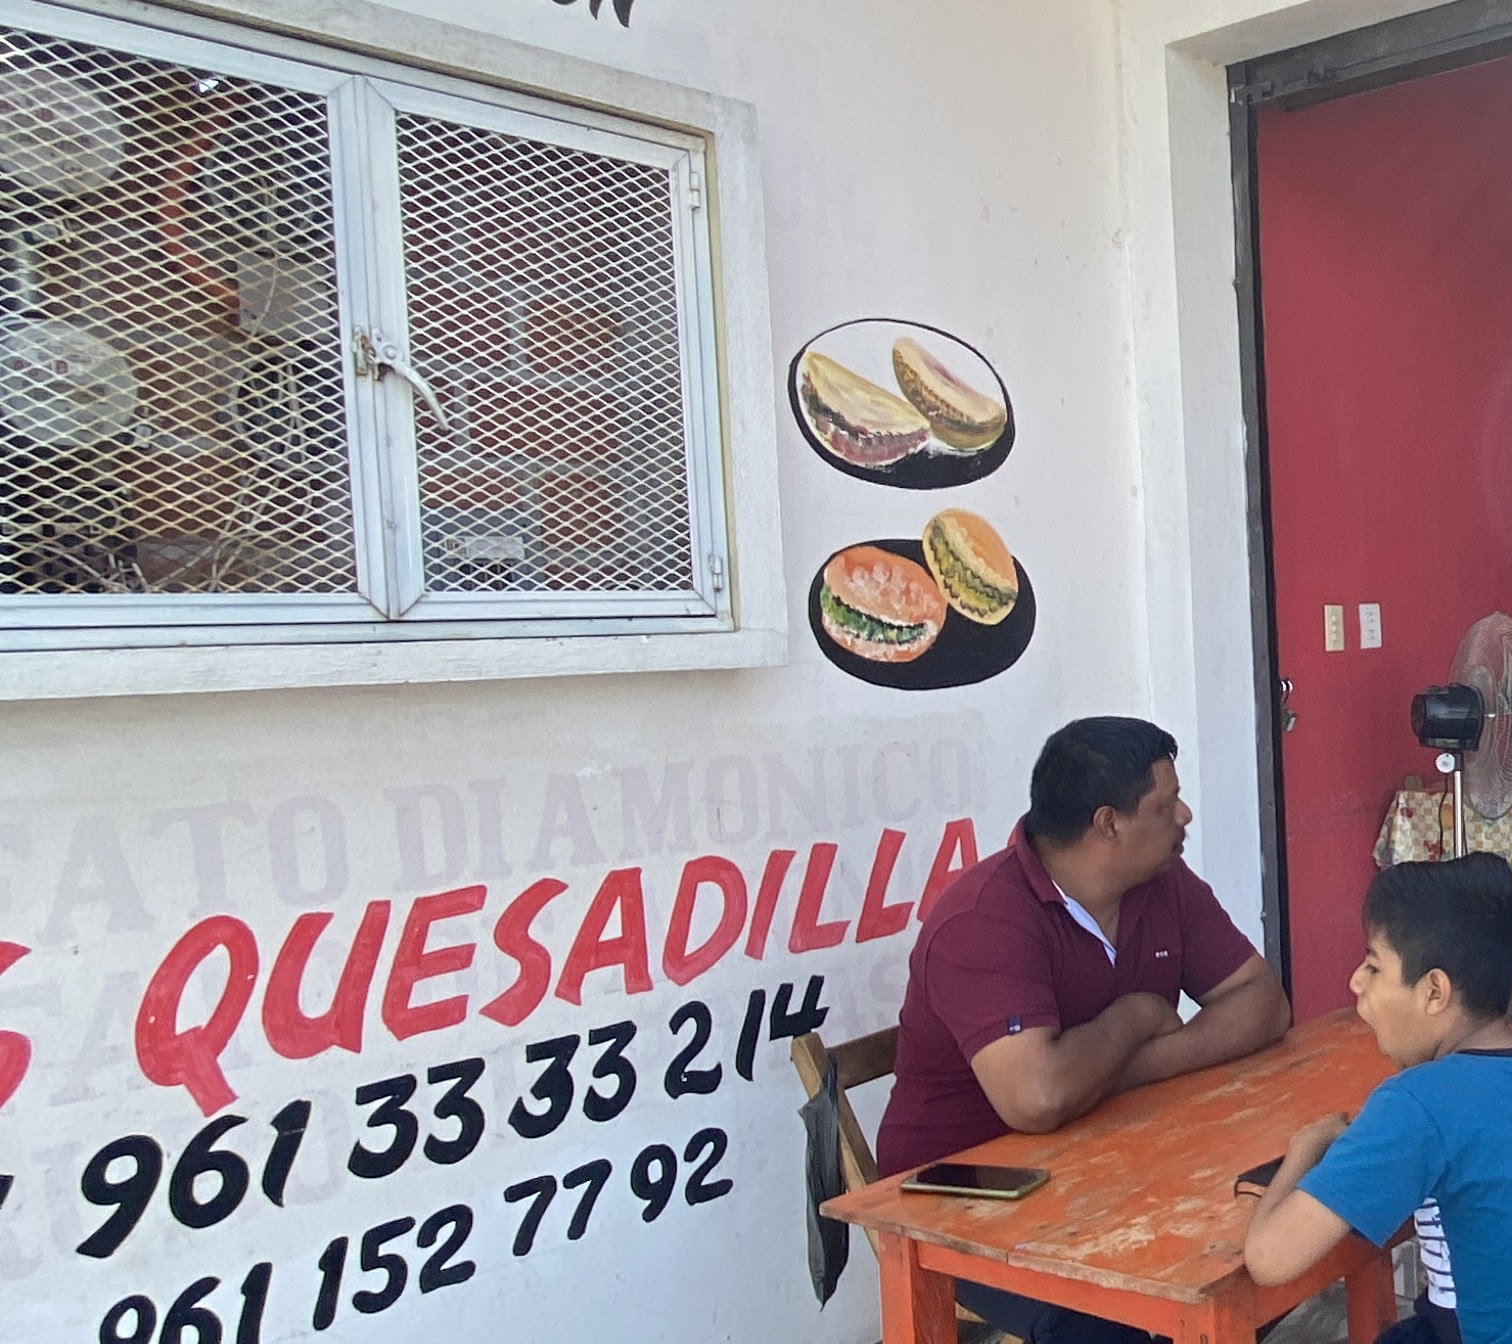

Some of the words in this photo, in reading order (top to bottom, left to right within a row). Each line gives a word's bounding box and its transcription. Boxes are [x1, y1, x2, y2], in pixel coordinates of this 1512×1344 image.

[134, 815, 1016, 1118] QUESADILLA
[75, 1100, 312, 1259] 961
[347, 1058, 486, 1179] 33
[507, 1021, 638, 1139] 33
[312, 1204, 476, 1332] 152
[503, 1158, 613, 1257] 77
[630, 1127, 734, 1223] 92
